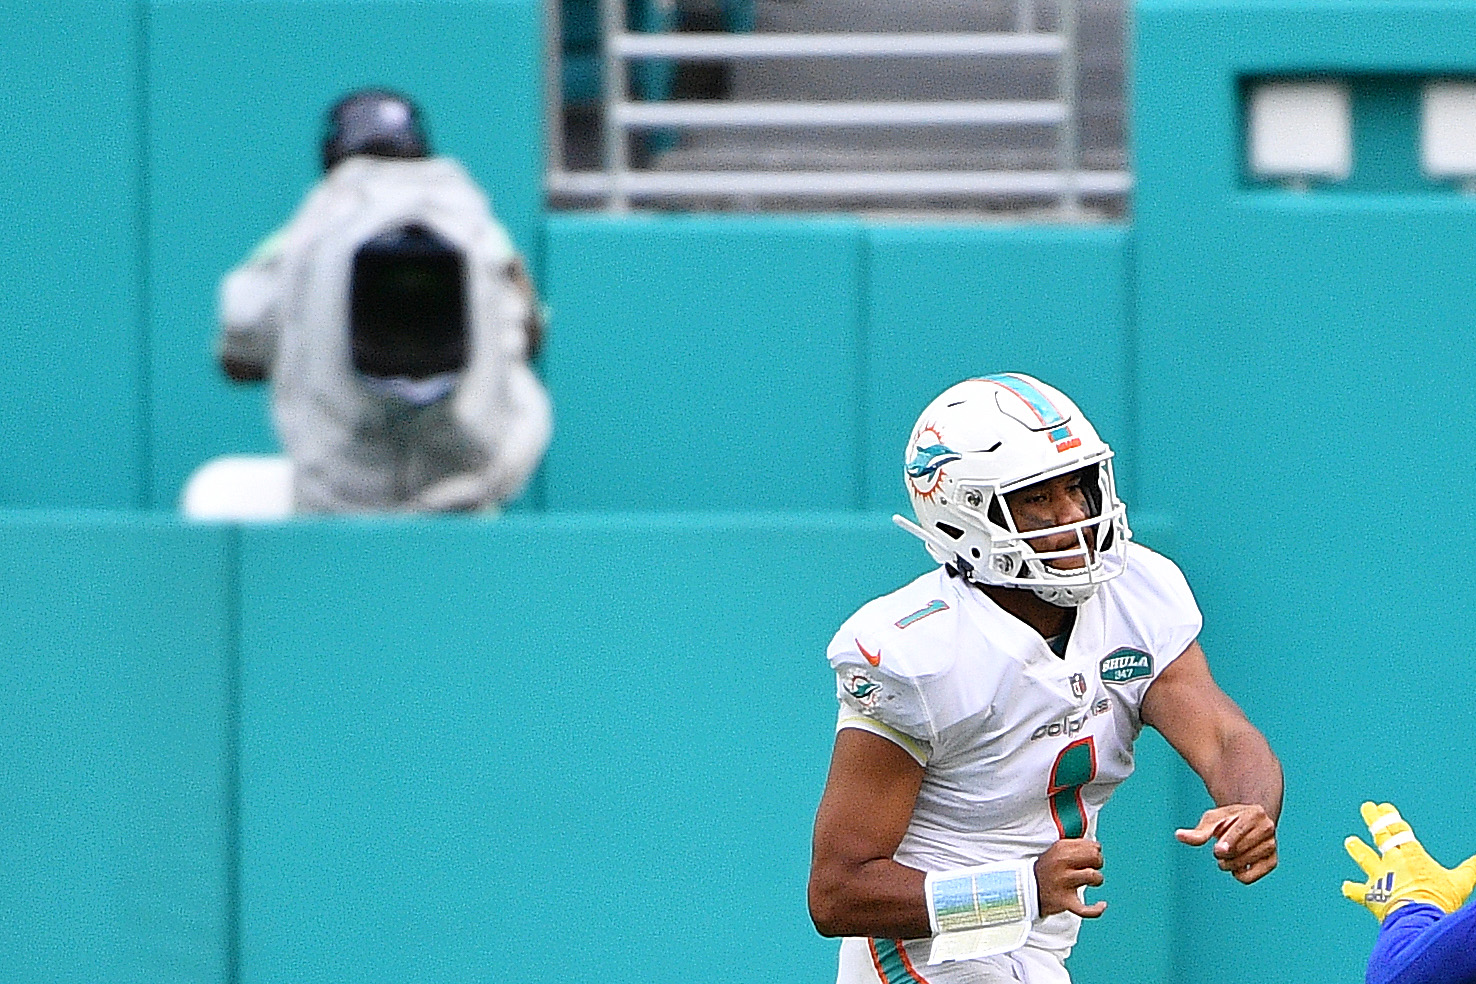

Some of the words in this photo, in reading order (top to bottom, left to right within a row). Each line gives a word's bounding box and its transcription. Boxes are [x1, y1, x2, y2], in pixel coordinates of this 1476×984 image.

[894, 599, 950, 629] 1
[1101, 656, 1149, 673] SHULA
[1047, 735, 1097, 840] 1
